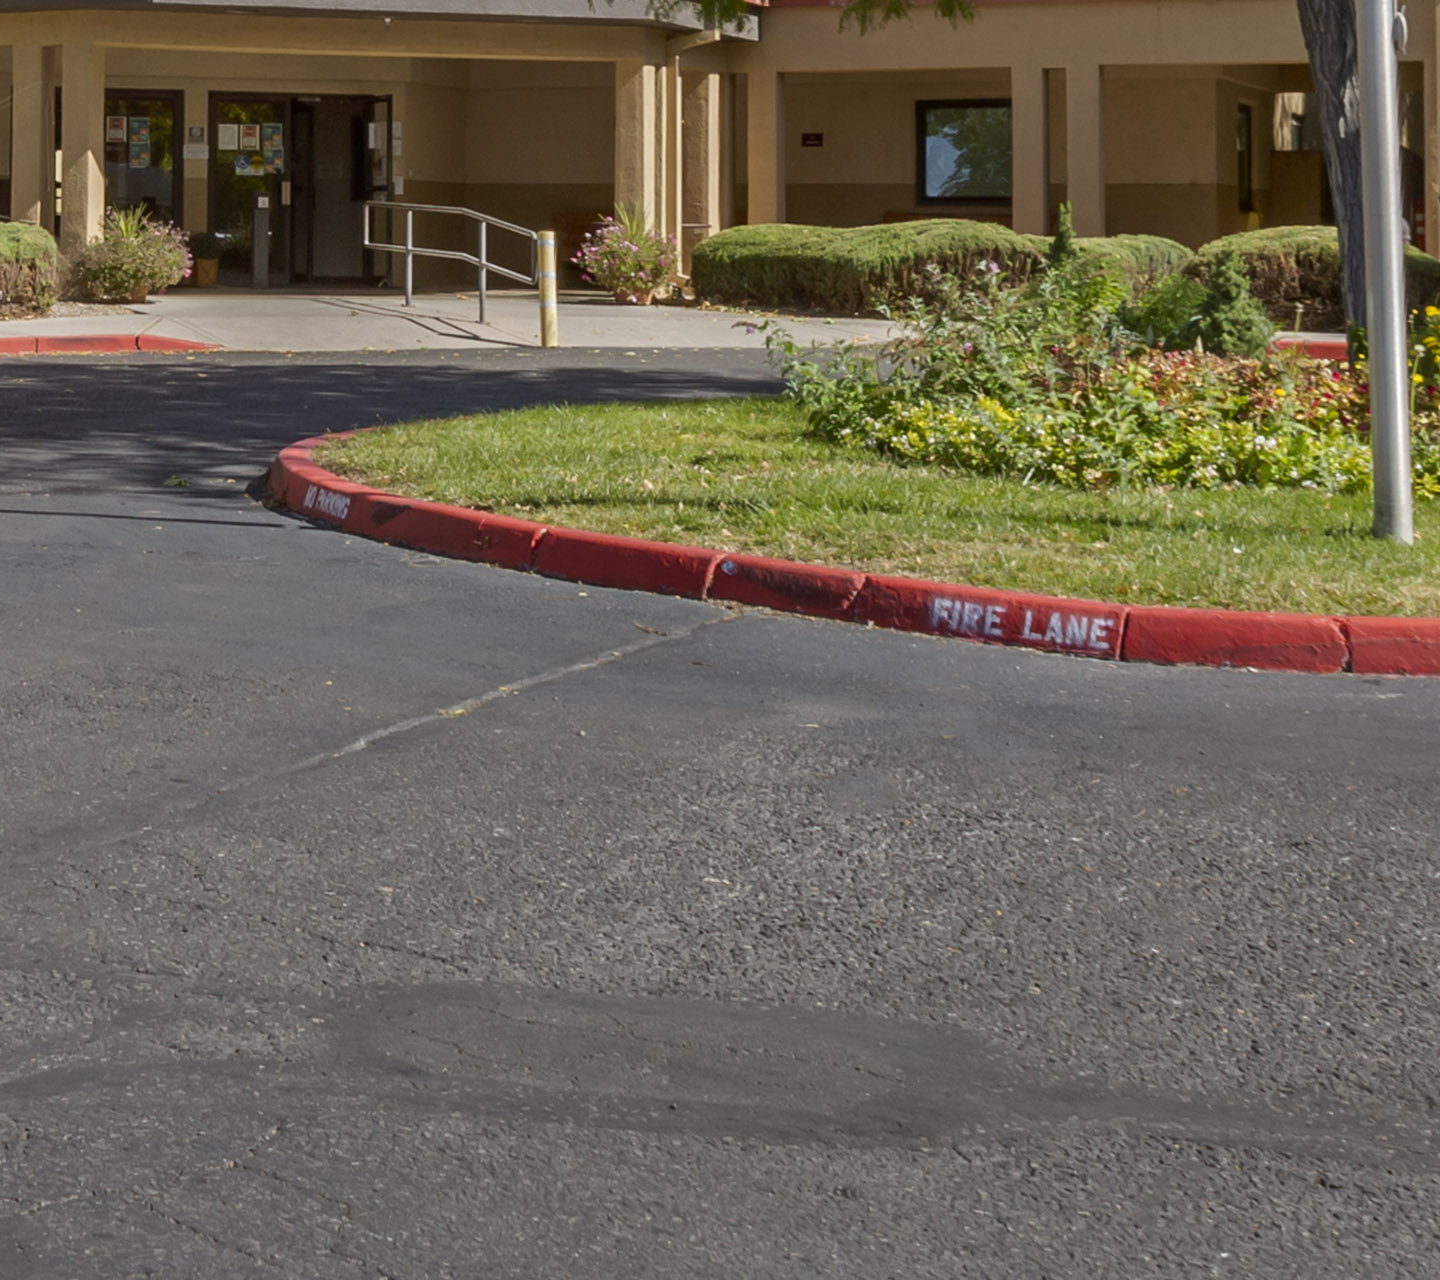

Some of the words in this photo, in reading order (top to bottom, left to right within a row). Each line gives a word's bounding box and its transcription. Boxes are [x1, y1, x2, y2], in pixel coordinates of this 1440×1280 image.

[304, 483, 318, 508] NO
[931, 597, 1007, 637] FIRE
[1022, 609, 1114, 649] LANE
